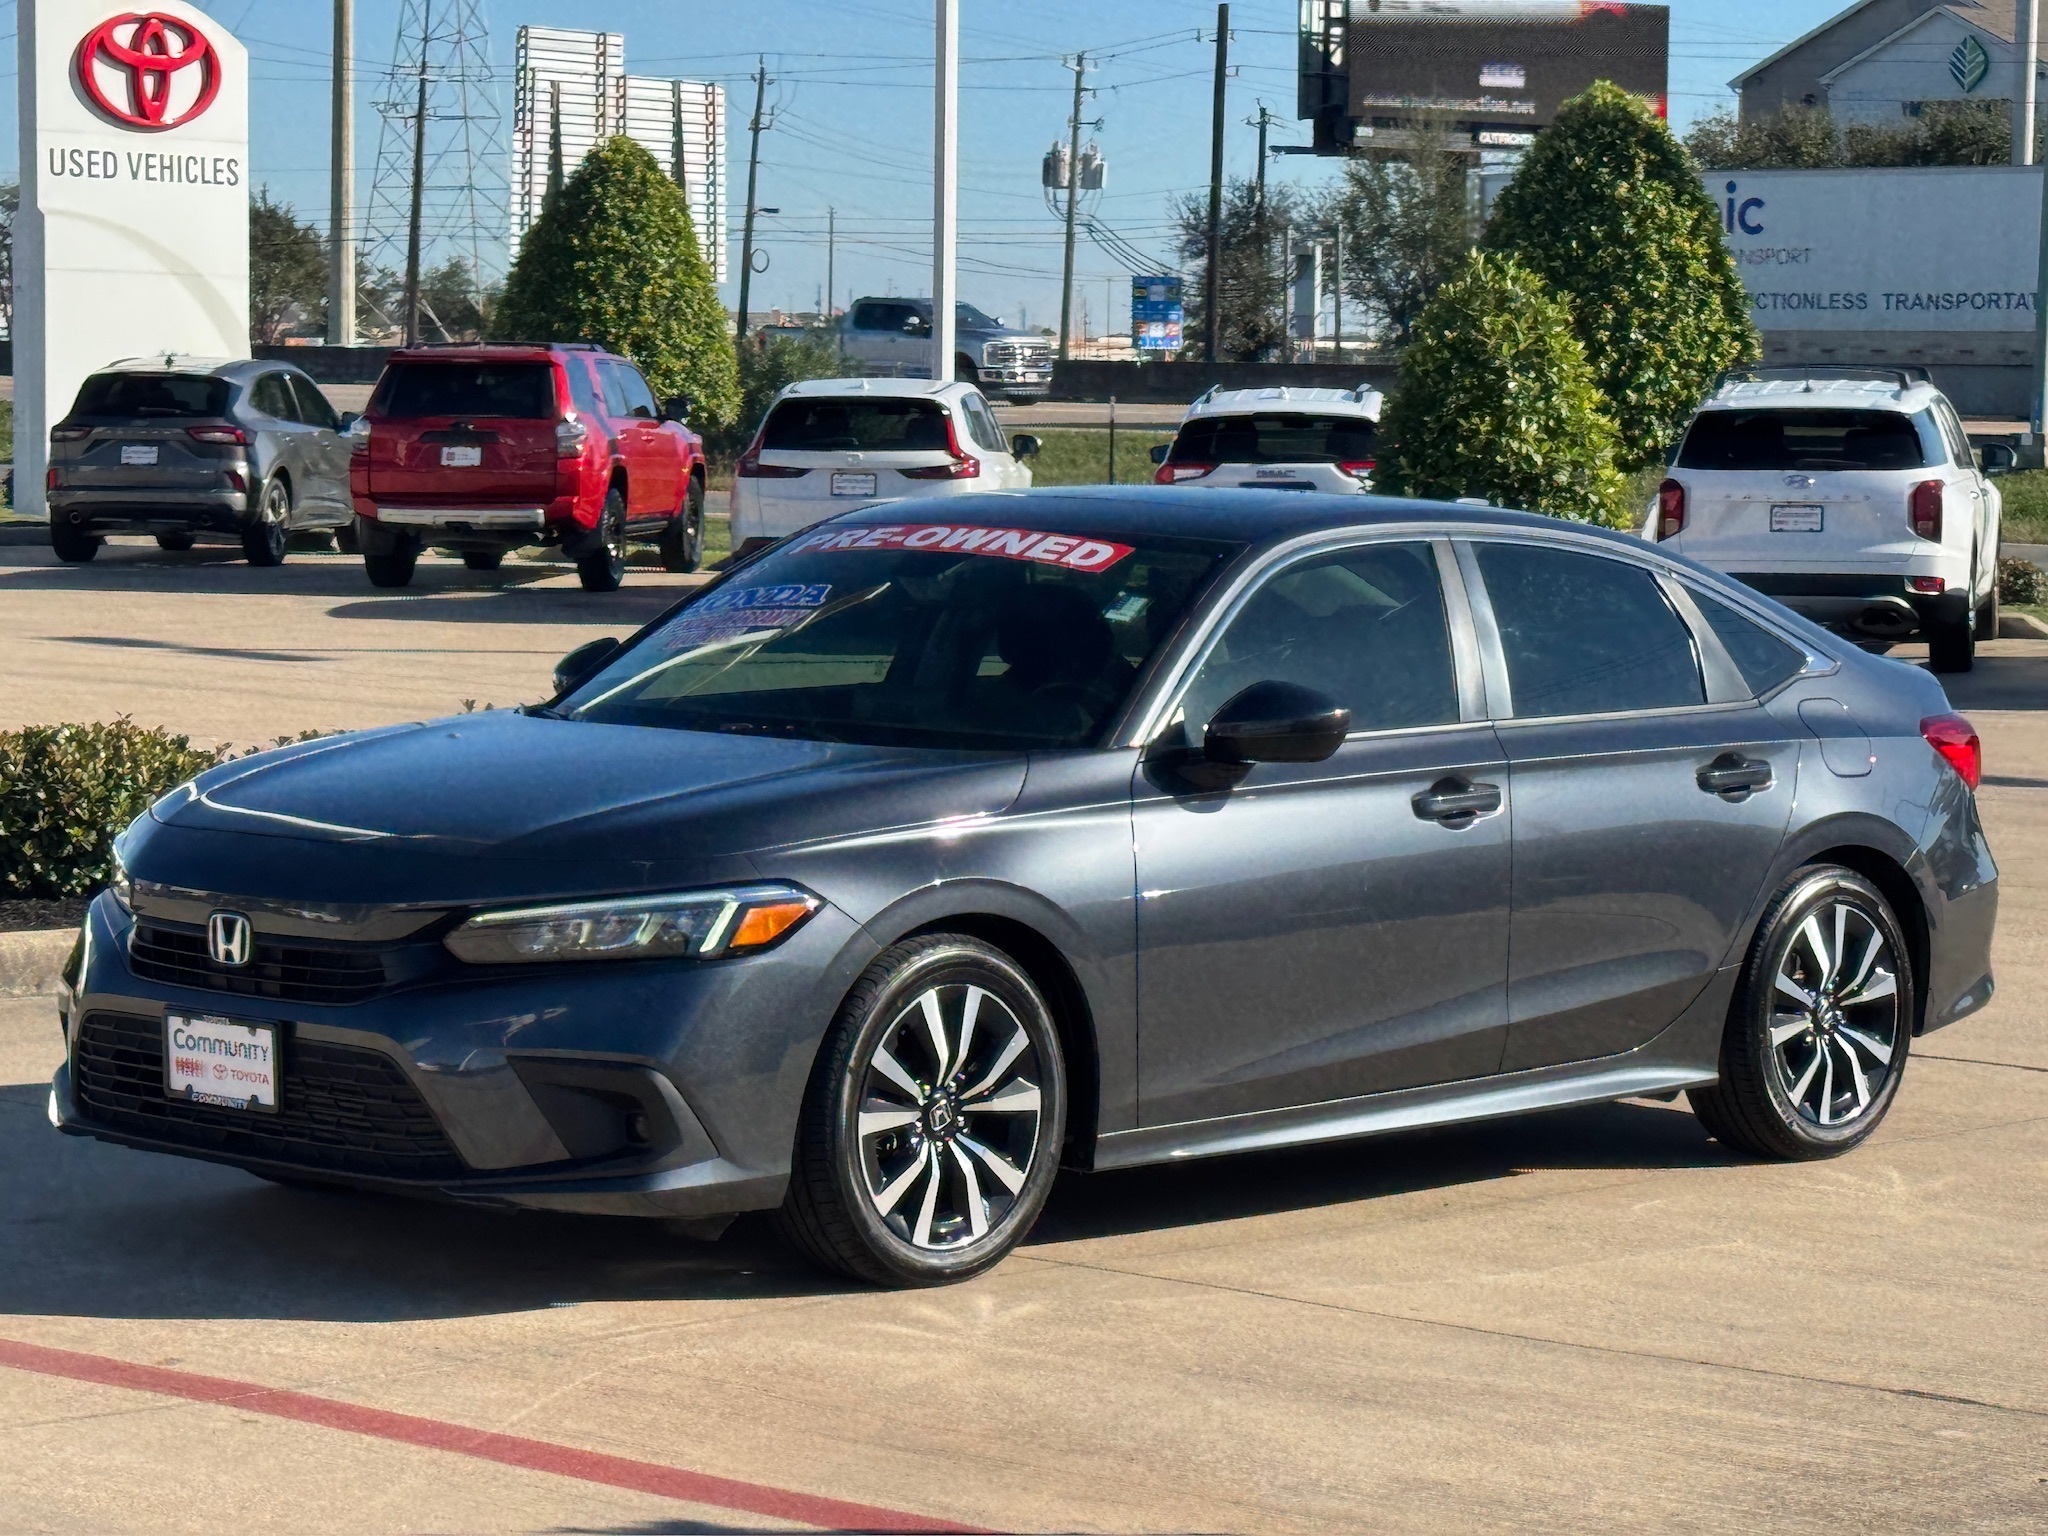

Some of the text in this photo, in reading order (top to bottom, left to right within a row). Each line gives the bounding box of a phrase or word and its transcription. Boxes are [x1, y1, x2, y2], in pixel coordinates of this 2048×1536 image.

[49, 147, 240, 187] USED VEHICLES
[1737, 247, 1813, 266] NSPORT
[1754, 291, 1868, 311] CTIONLESS
[789, 525, 1116, 567] PRE-OWNED
[230, 1068, 270, 1086] TOYOTA
